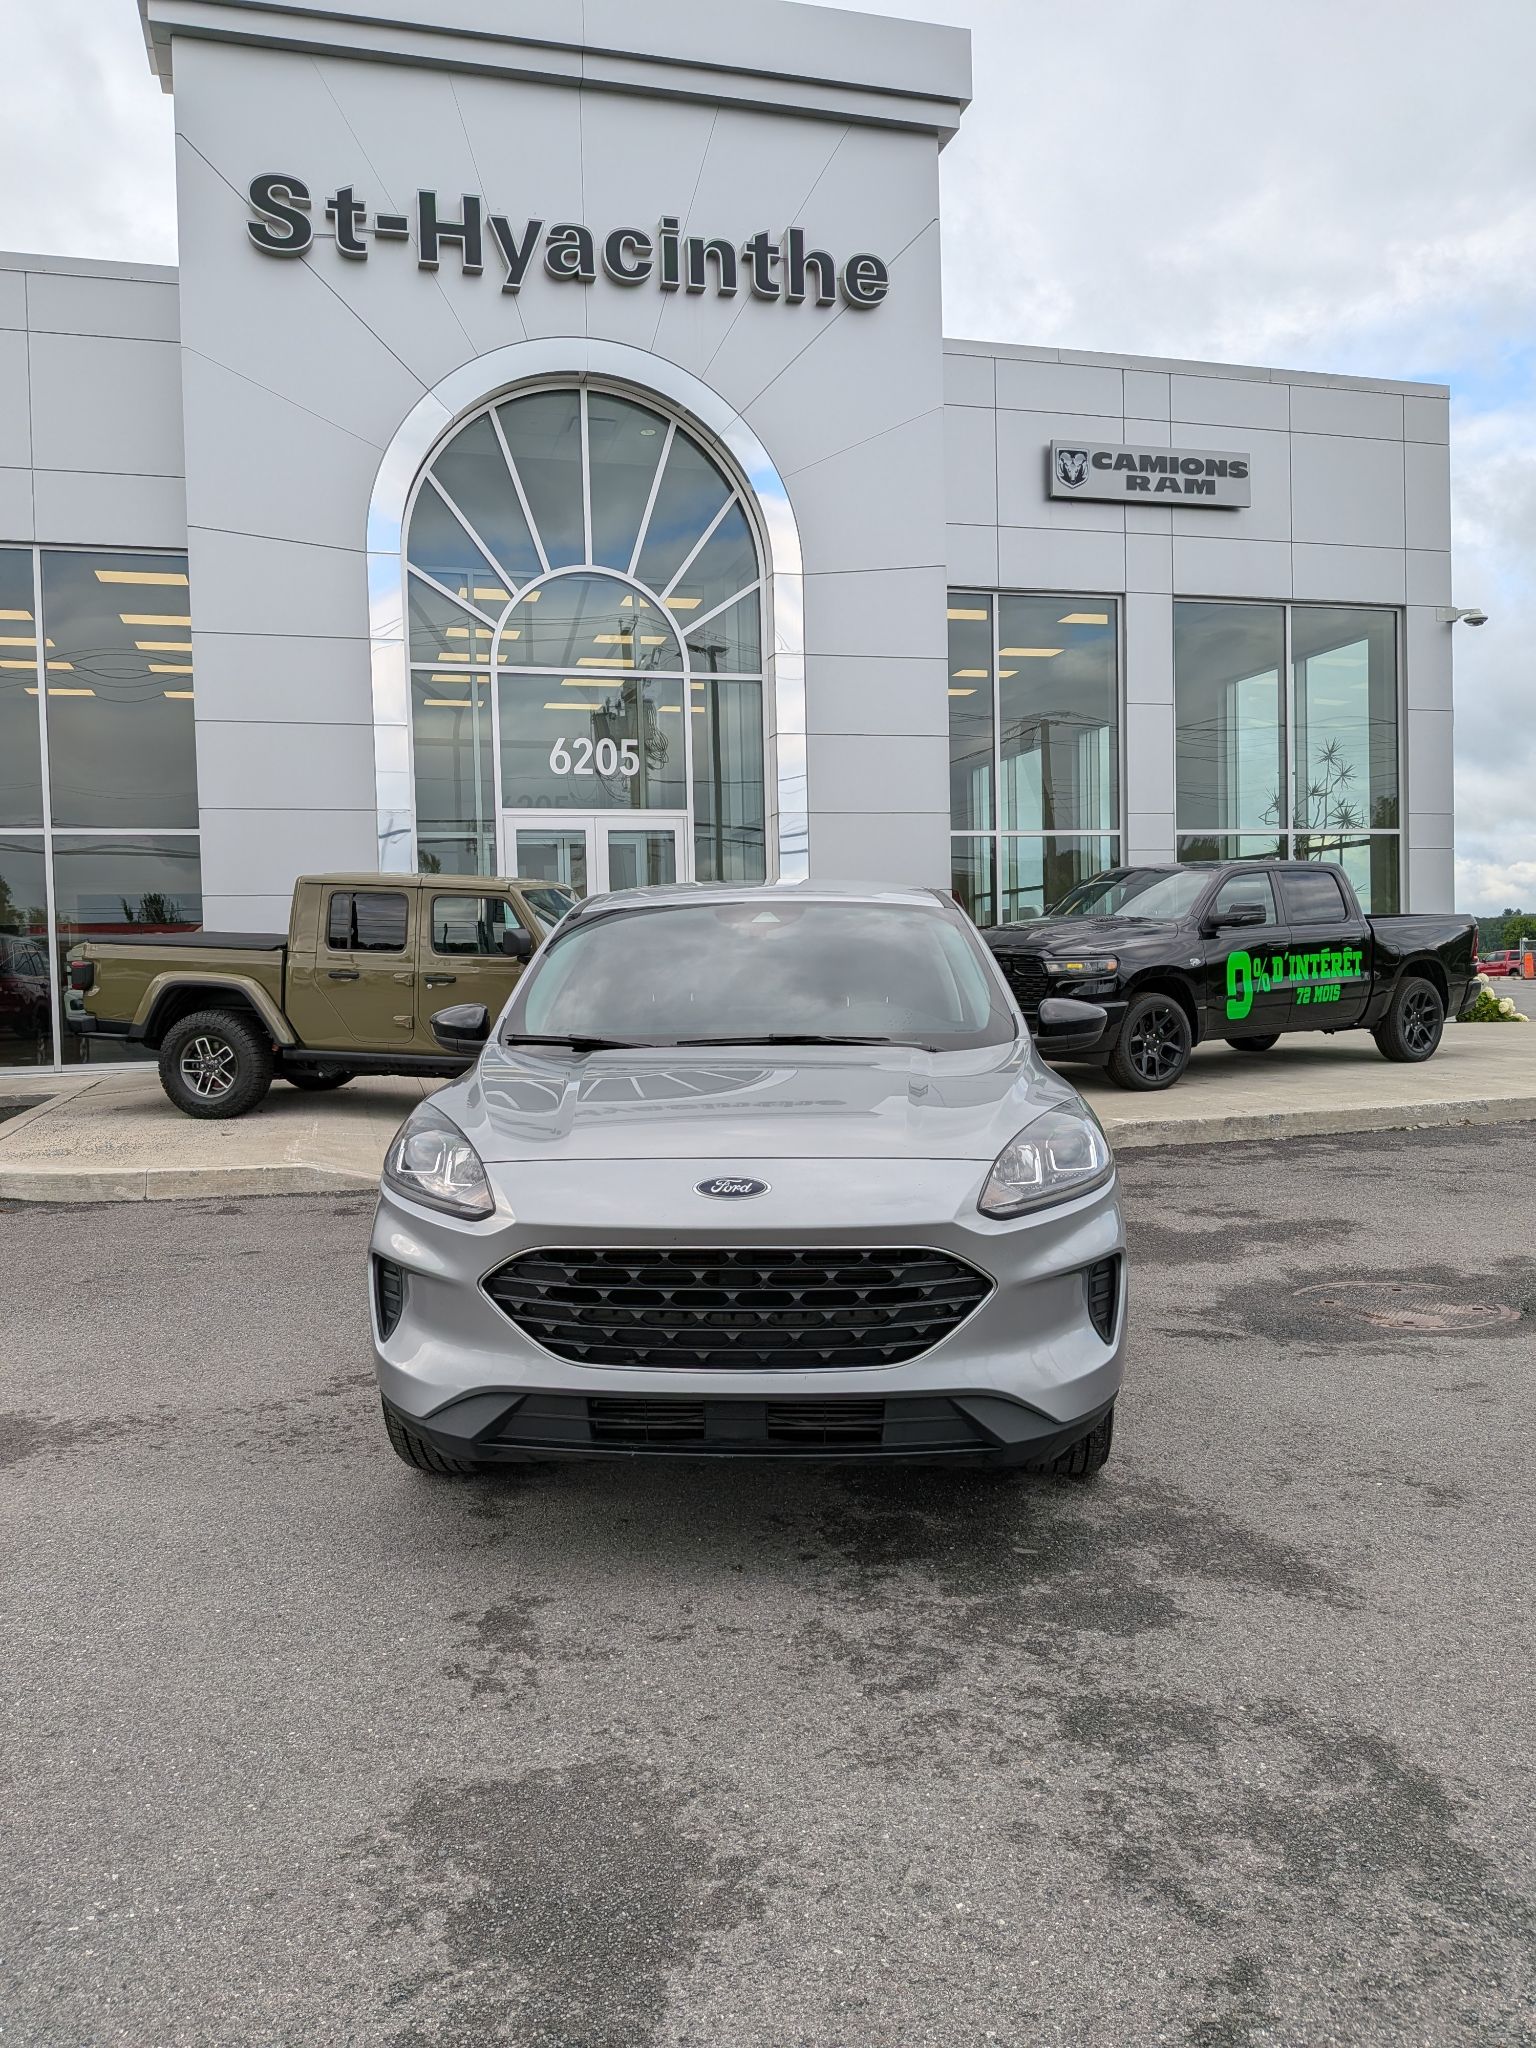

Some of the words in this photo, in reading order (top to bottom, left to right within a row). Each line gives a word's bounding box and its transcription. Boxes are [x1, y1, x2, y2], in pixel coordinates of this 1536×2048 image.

[246, 172, 890, 309] St-Hyacinthe
[1092, 452, 1249, 478] CAMIONS
[1125, 475, 1216, 495] RAM
[549, 737, 640, 776] 6205
[1296, 986, 1311, 1004] 72
[1313, 984, 1341, 1002] MOIS
[710, 1179, 753, 1193] Ford
